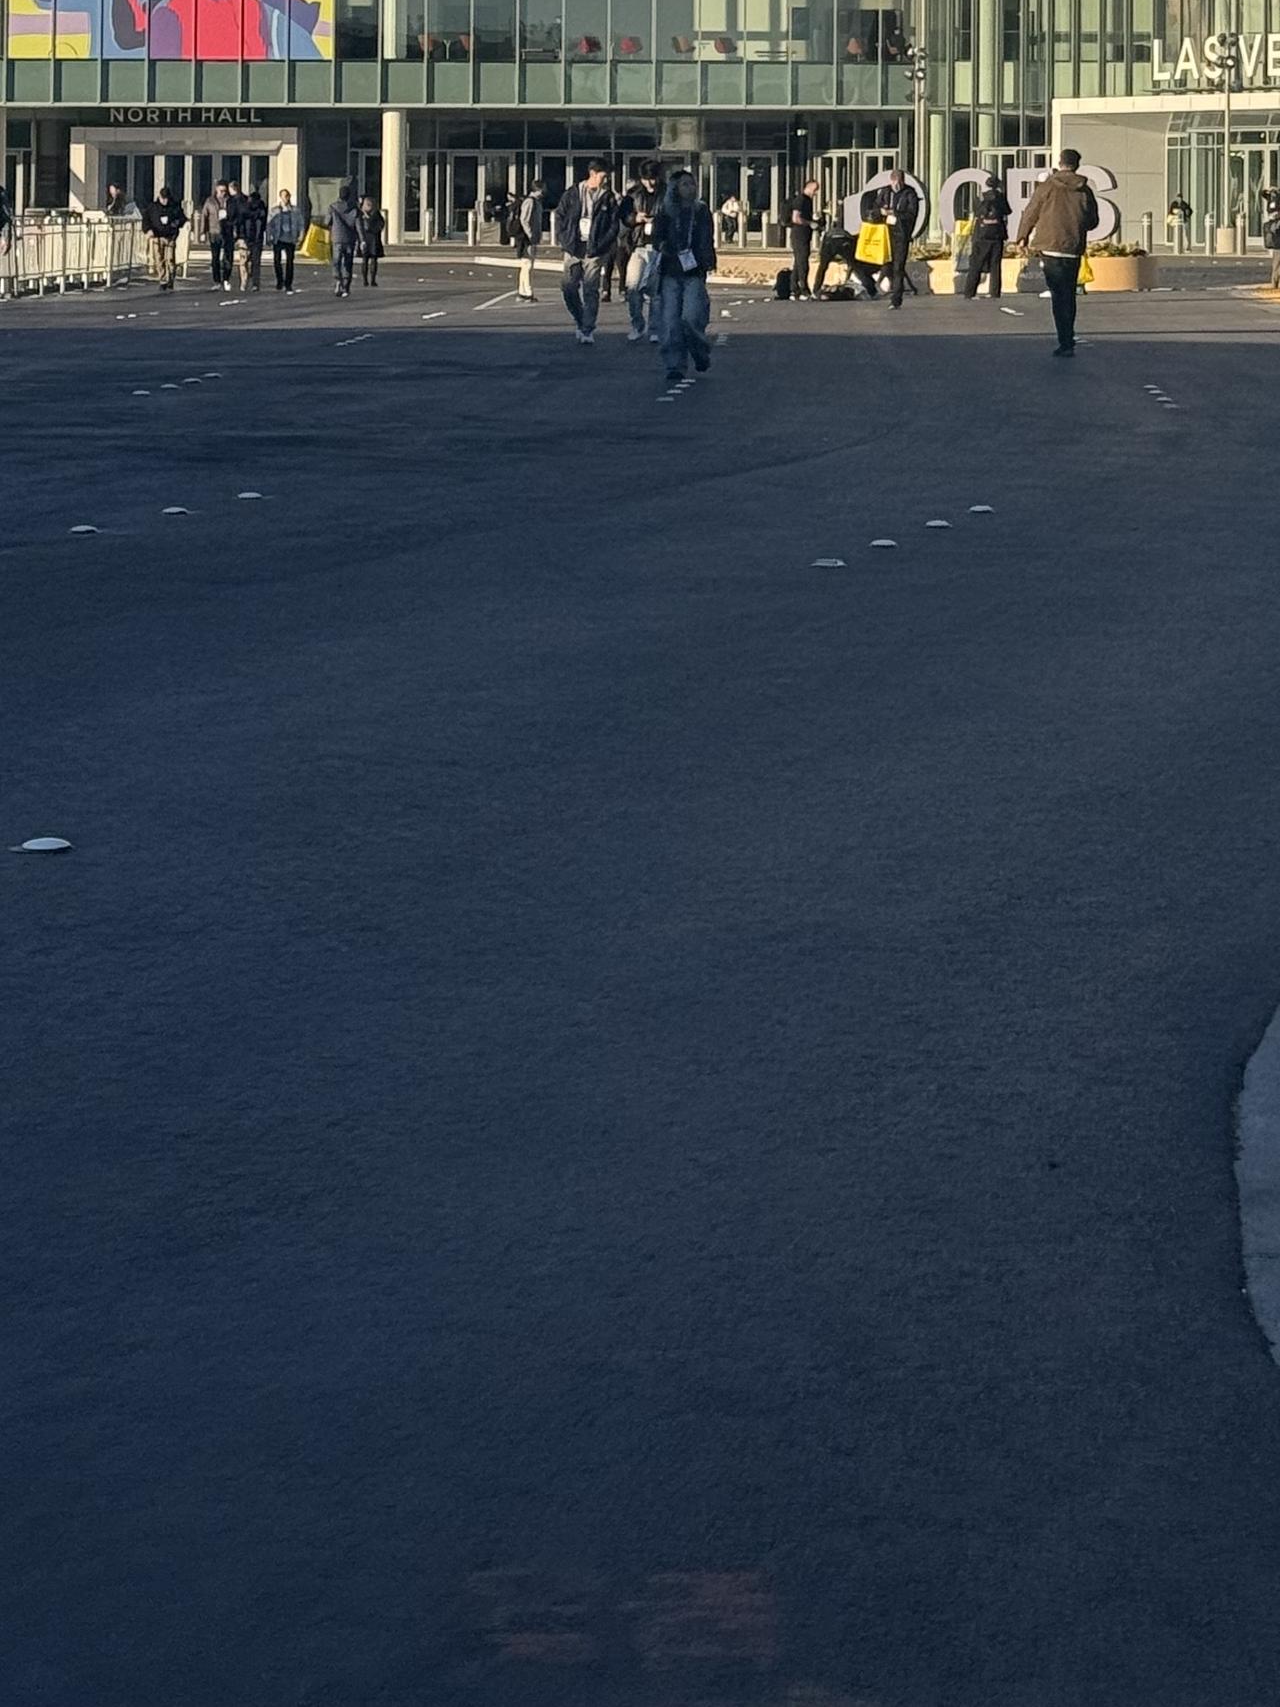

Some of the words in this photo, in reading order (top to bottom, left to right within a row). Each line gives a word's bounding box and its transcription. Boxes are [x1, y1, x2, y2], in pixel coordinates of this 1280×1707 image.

[1153, 35, 1225, 81] LAS
[109, 107, 192, 123] NORTH
[201, 107, 262, 123] HALL
